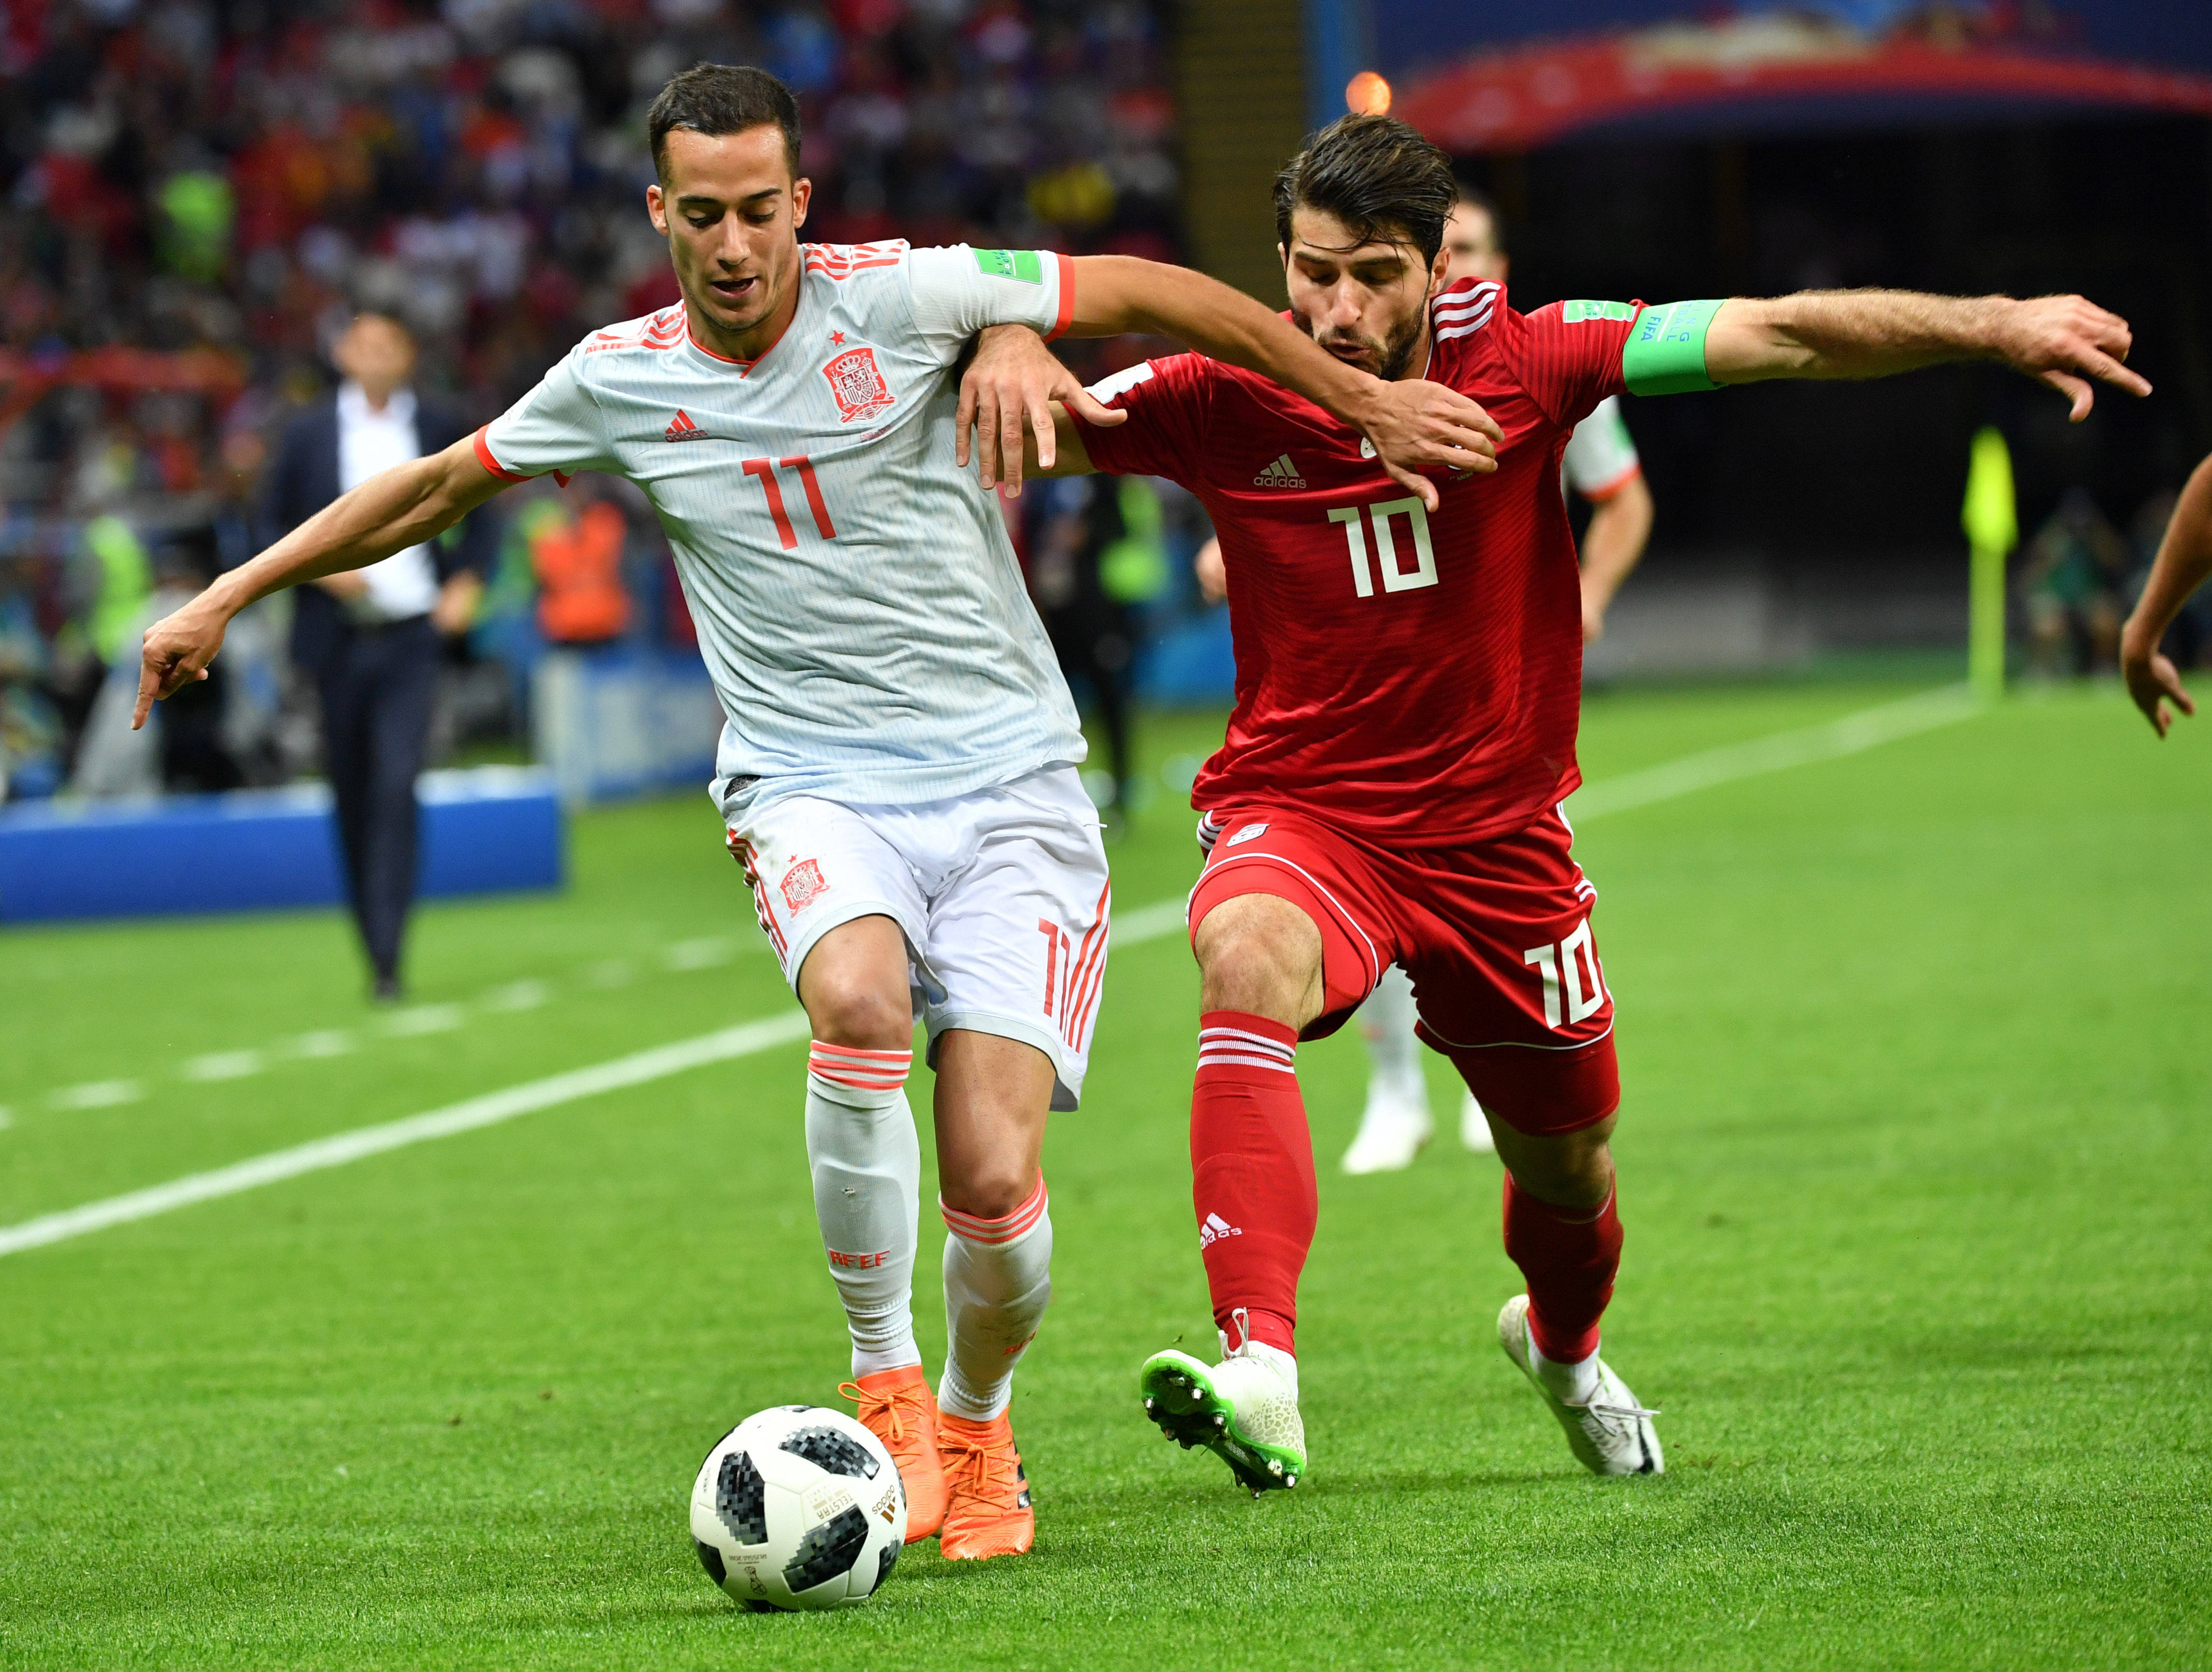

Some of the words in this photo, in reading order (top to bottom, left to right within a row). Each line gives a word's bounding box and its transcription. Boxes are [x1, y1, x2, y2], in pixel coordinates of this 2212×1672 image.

[1641, 317, 1661, 341] FIFA
[665, 430, 708, 443] adidas
[1253, 475, 1307, 488] adidas
[741, 455, 836, 551] 11
[1327, 496, 1438, 597] 10
[1039, 917, 1070, 1033] 11
[1524, 917, 1604, 1029] 10
[829, 1250, 890, 1269] RFEF
[816, 1493, 853, 1520] TELSTAR
[872, 1485, 894, 1515] adidas
